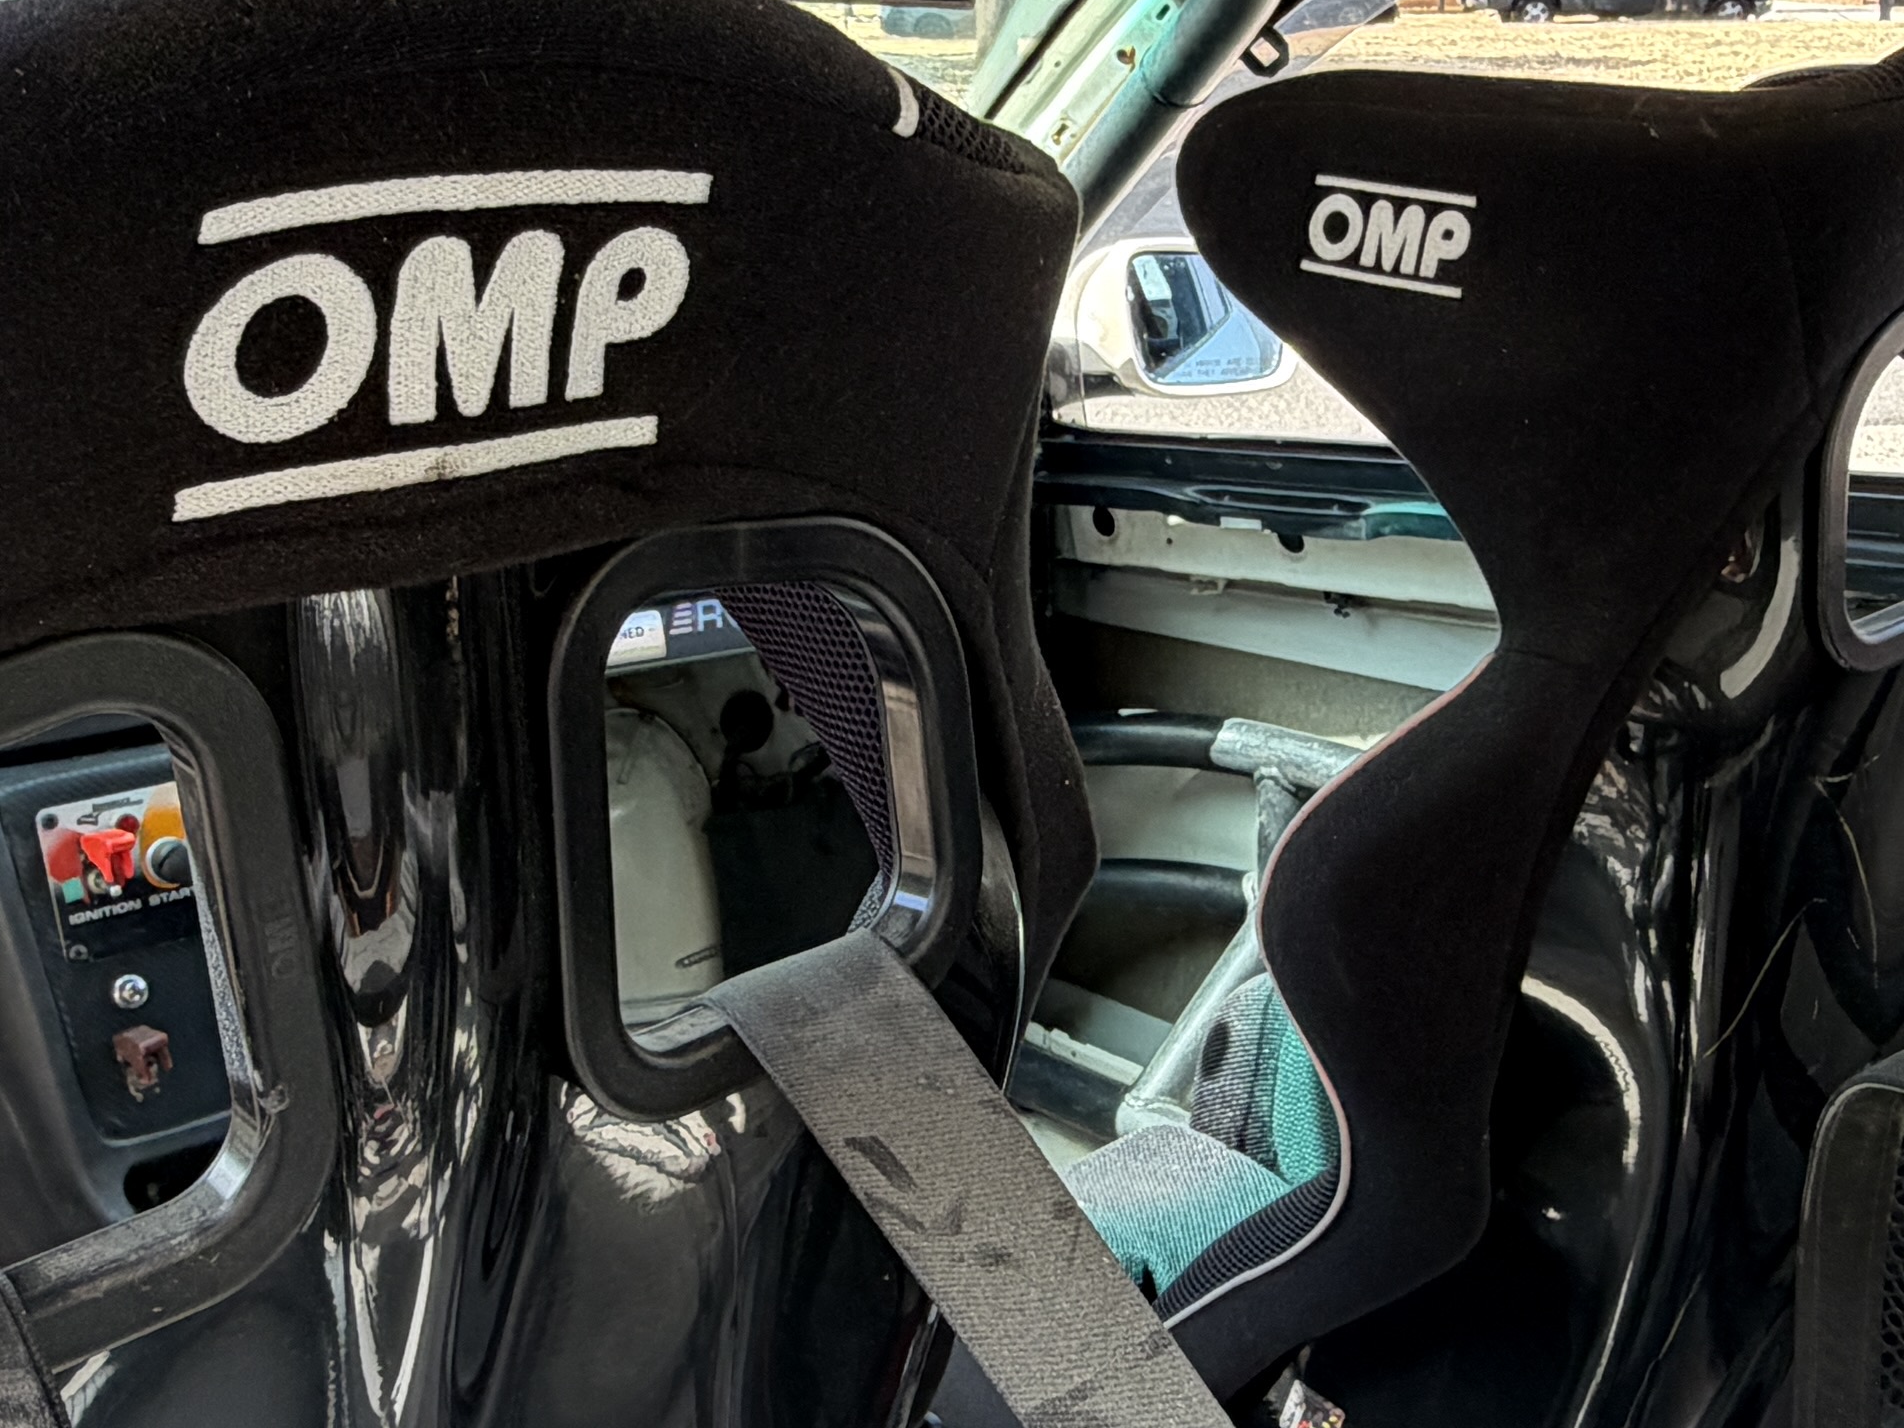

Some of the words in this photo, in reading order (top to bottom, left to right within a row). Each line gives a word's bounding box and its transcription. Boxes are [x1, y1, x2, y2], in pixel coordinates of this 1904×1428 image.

[1309, 193, 1471, 278] OMP
[183, 226, 691, 444] OMP
[69, 899, 142, 925] IGNITION
[149, 886, 194, 907] STAR
